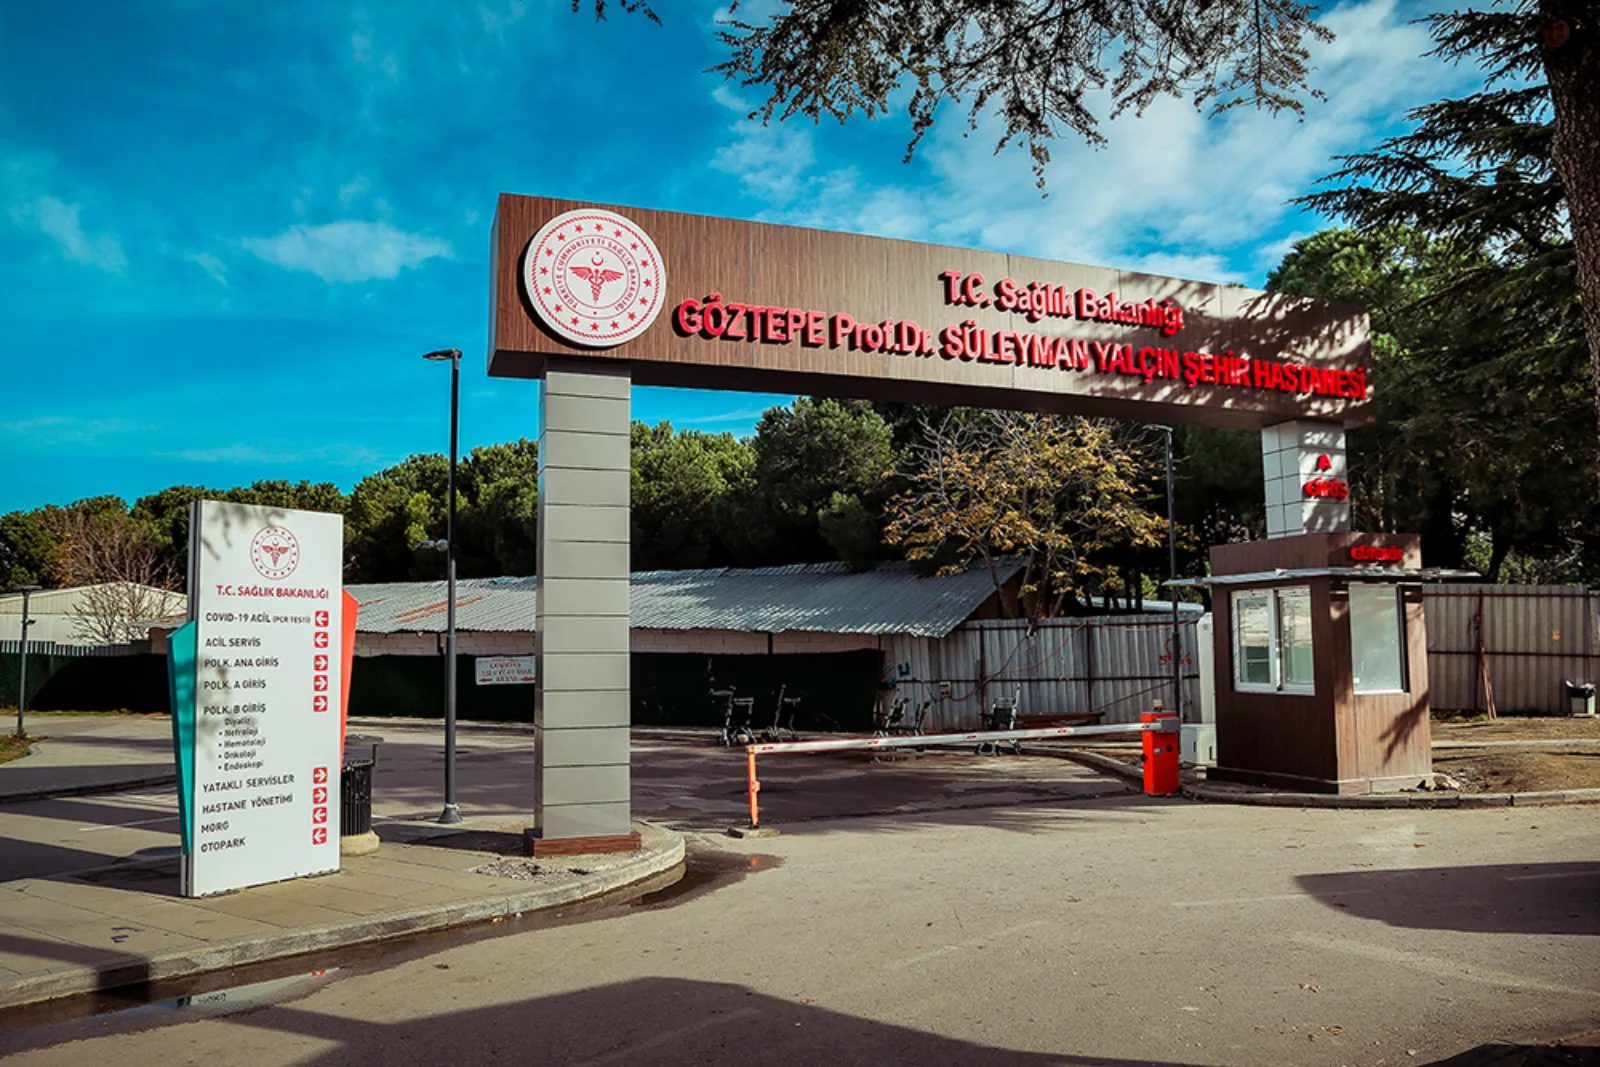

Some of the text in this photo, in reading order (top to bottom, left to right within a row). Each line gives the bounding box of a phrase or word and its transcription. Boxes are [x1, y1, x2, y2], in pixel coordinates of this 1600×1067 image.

[942, 270, 1185, 337] T.C. Sağlık Bakanlığı
[677, 293, 827, 344] GÖZTEPE
[941, 319, 1089, 370] SÜLEYMAN
[1091, 340, 1179, 384] YALÇIN
[1182, 350, 1250, 388] ŞEHİR
[1252, 359, 1367, 400] HASTANESİ
[1316, 453, 1332, 472] A
[216, 585, 329, 599] T.C. SAĞLIK BAKANLIĞI
[205, 612, 249, 623] COVID-19
[250, 611, 271, 623] ACİL
[205, 636, 262, 647] ACİL SERVİS
[204, 657, 232, 668] POLK.
[234, 657, 254, 667] ANA
[204, 680, 232, 690] POLK.
[234, 680, 241, 689] A
[203, 705, 232, 715] POLK.
[233, 704, 241, 714] B
[203, 773, 295, 793] YATAKLI SERVİSLER
[202, 799, 247, 814] HASTANE
[201, 820, 230, 834] MORG
[201, 837, 246, 853] OTOPARK
